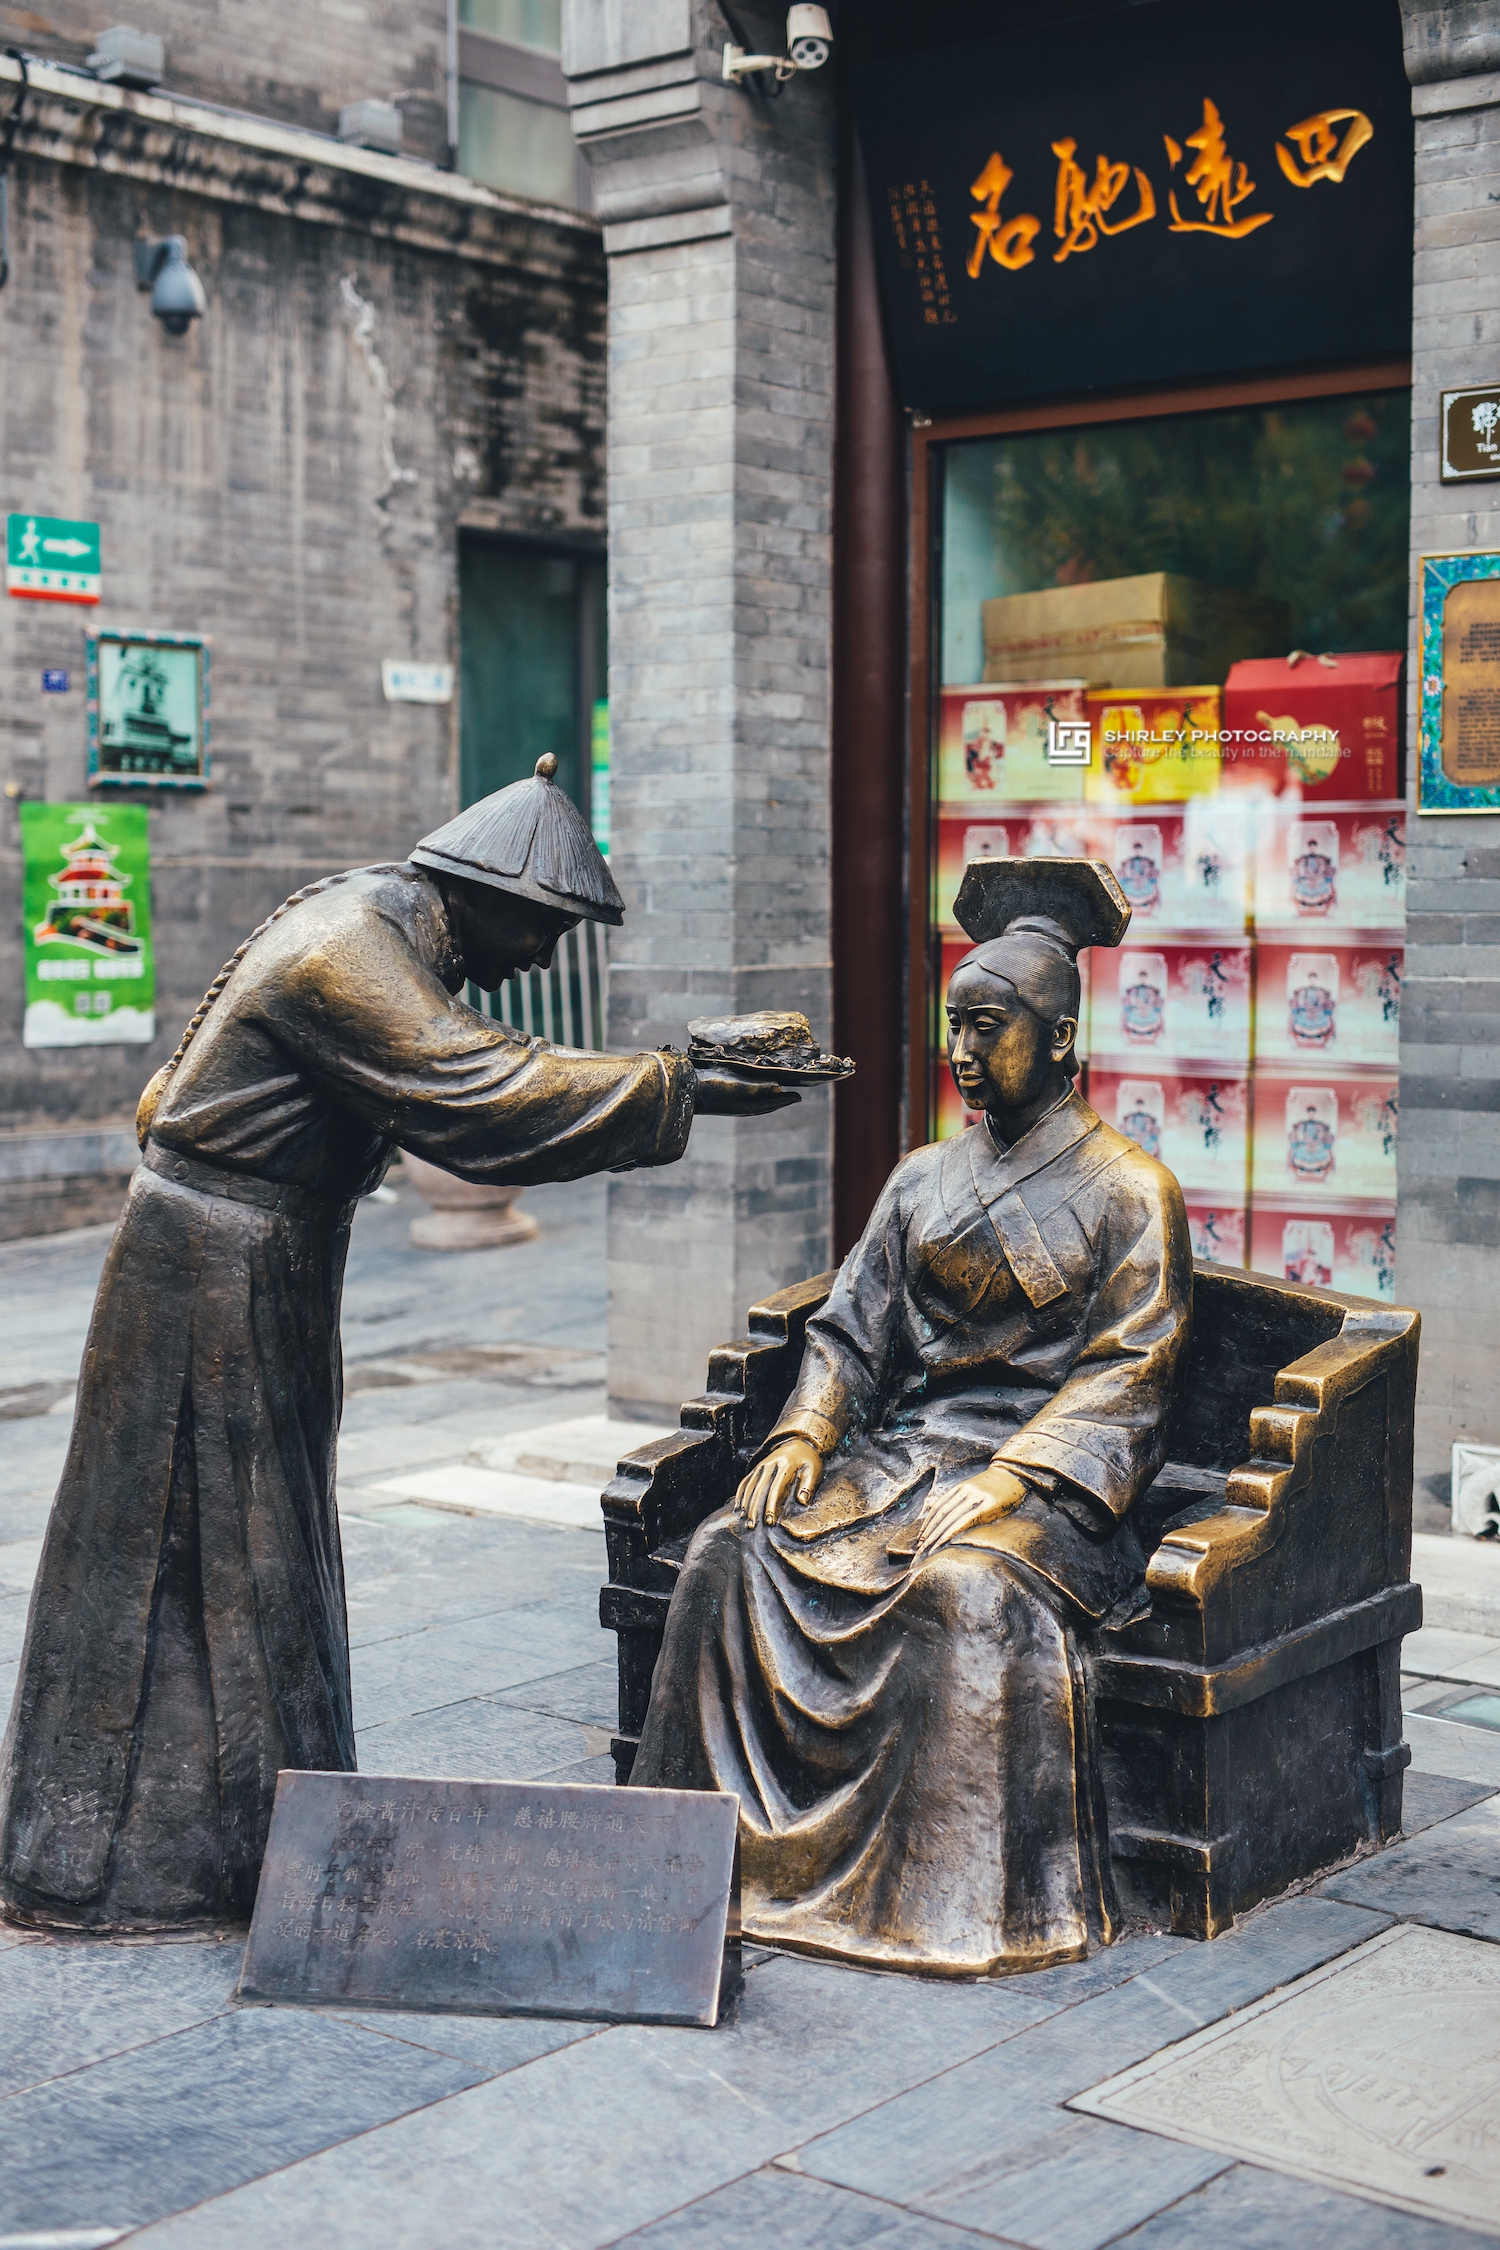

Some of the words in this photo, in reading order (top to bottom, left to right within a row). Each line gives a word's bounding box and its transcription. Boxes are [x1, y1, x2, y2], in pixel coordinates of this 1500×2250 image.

[1476, 442, 1498, 454] Tian
[332, 1797, 489, 1826] 乾隆酱汁传百年
[513, 1805, 673, 1834] 慈禧腰牌通天下
